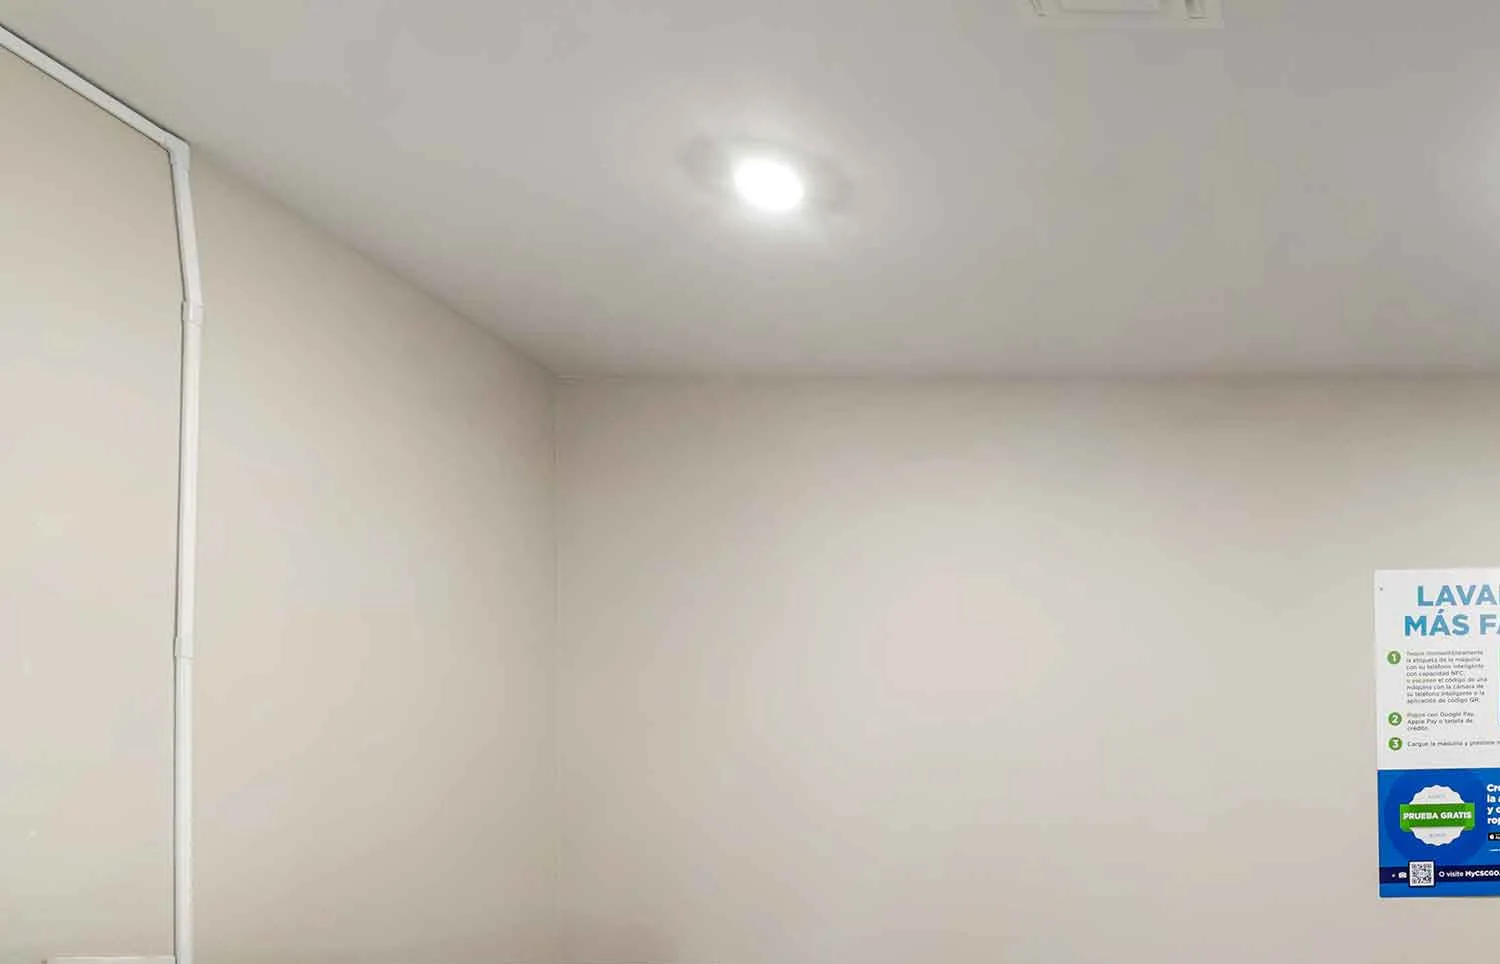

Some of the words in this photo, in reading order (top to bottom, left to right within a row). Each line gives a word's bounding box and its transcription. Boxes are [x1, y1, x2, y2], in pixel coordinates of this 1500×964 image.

[1404, 608, 1470, 637] MÁS
[1486, 794, 1496, 803] la
[1486, 806, 1493, 815] y
[1403, 812, 1439, 820] PRUEBA
[1440, 811, 1472, 819] GRATIS
